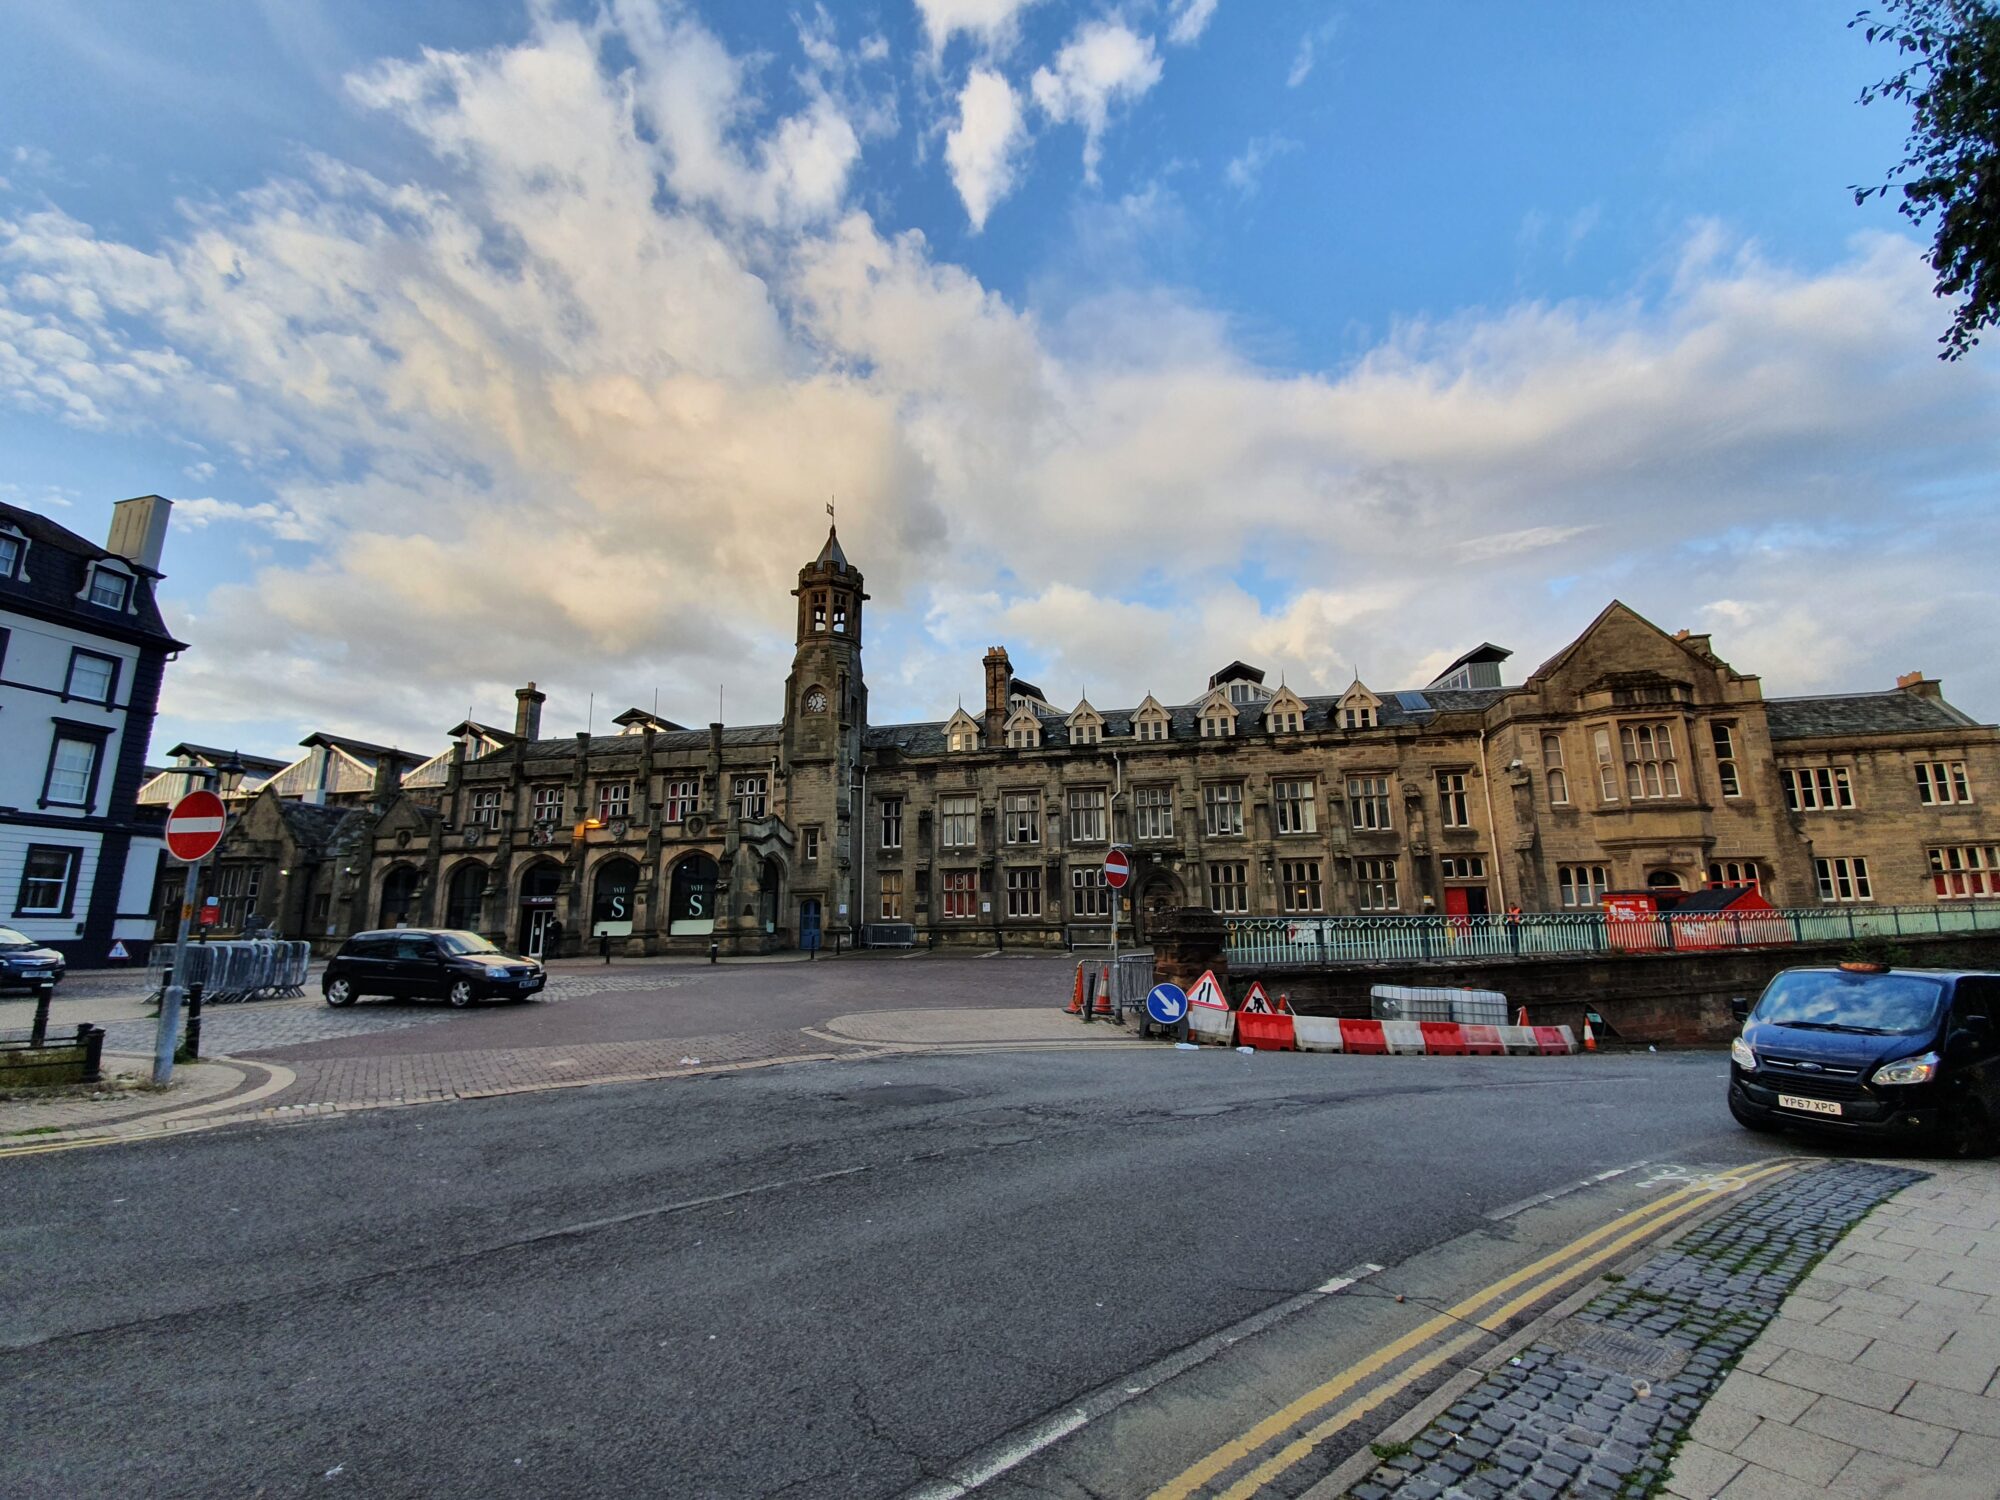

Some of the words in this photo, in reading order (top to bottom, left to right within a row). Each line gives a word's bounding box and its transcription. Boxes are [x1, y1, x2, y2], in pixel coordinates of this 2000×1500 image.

[690, 884, 703, 892] WH
[611, 896, 625, 918] S
[689, 894, 703, 917] S
[1783, 1096, 1811, 1109] YP67
[1814, 1102, 1836, 1113] XPG
